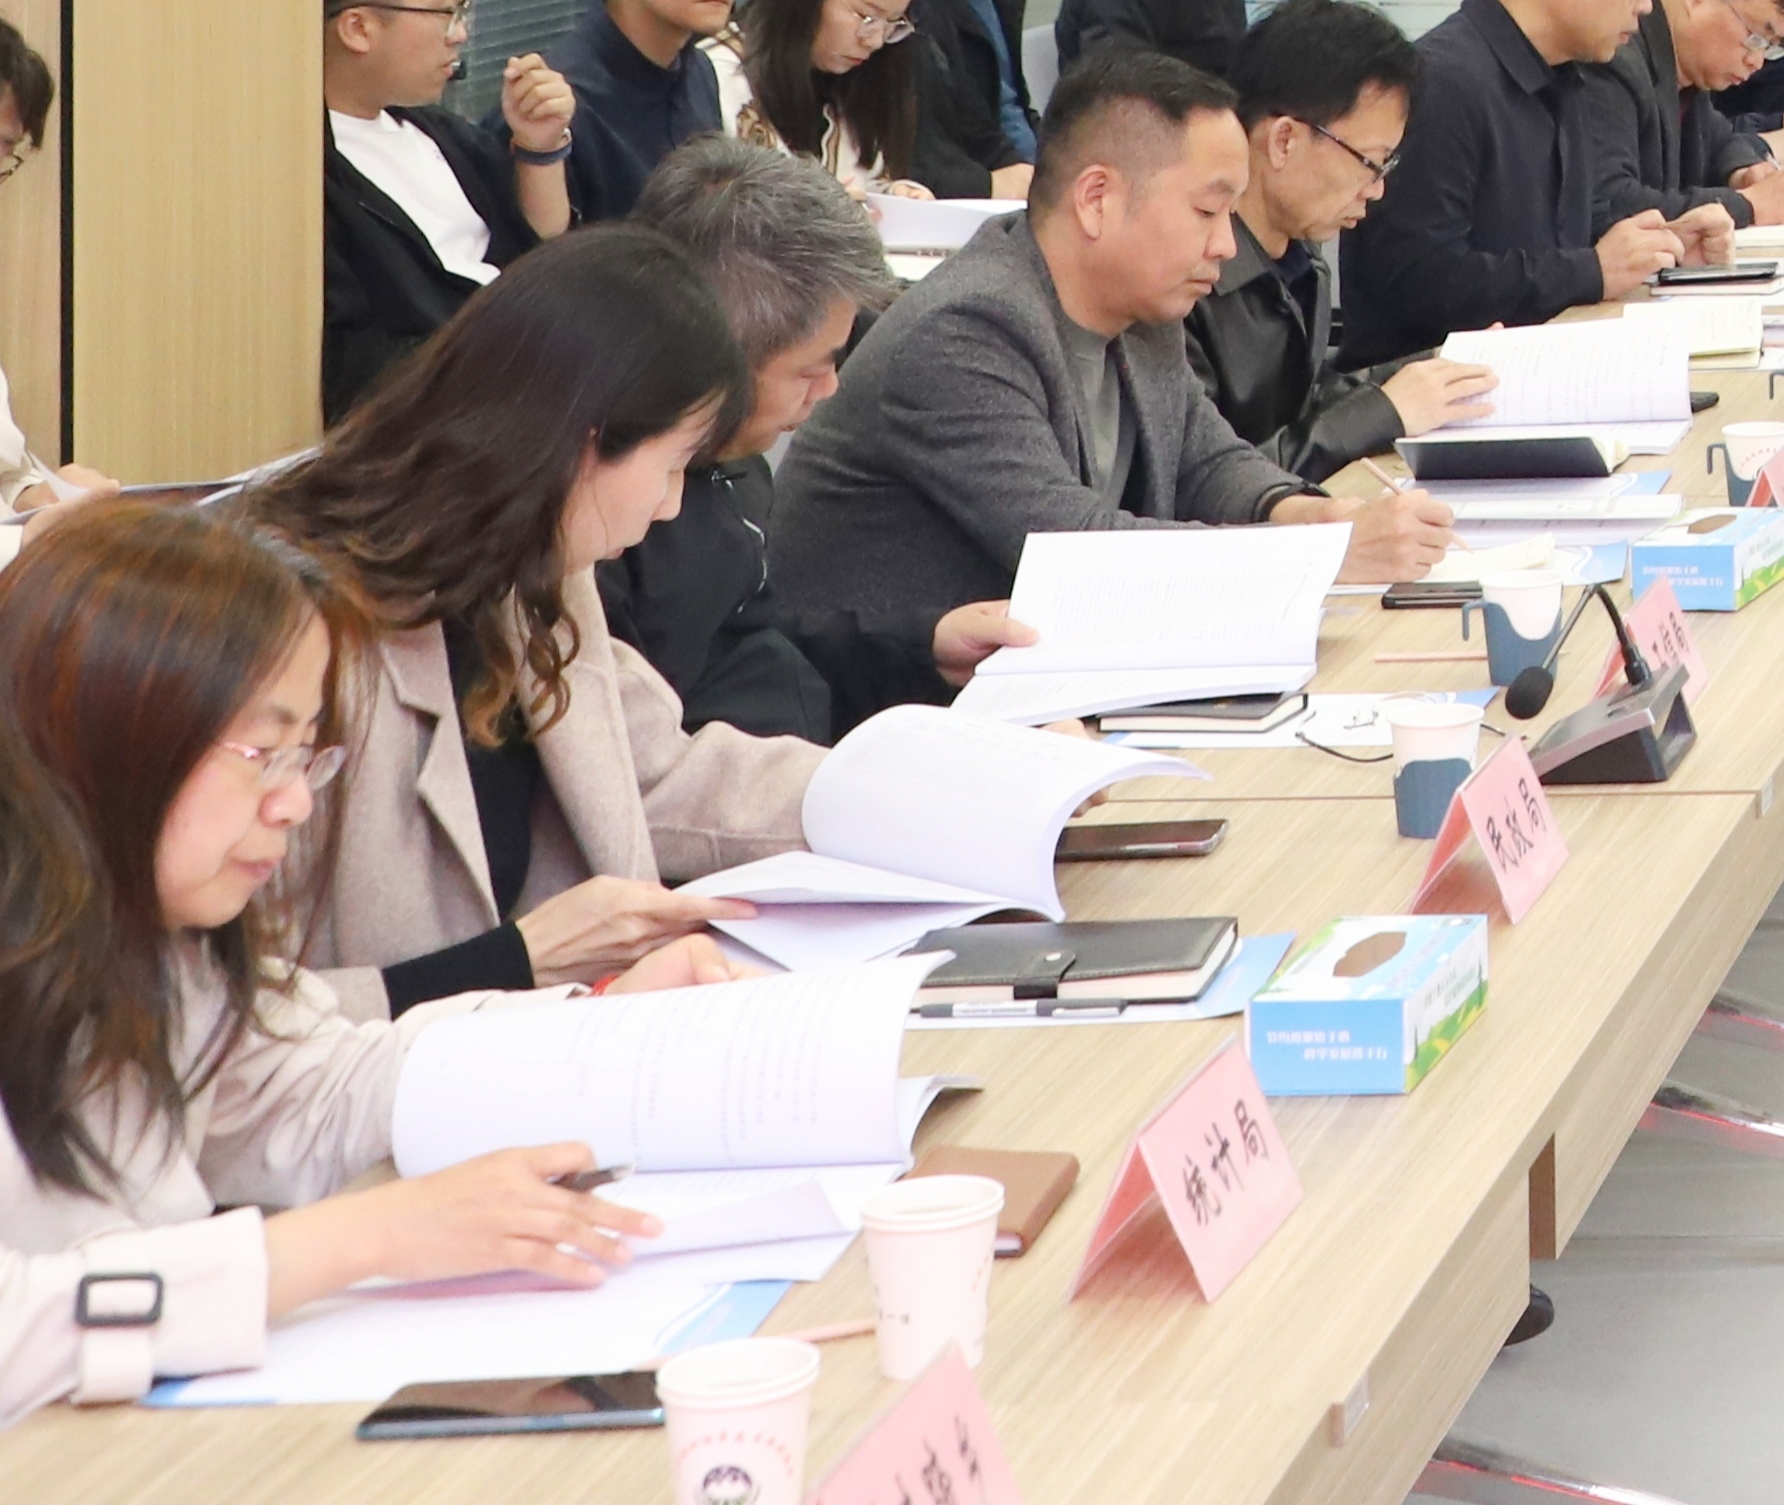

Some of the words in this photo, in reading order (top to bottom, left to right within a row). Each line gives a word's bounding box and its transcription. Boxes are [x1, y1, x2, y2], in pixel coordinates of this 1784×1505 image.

[1486, 777, 1547, 872] 民政局
[1182, 1099, 1269, 1226] 统计局
